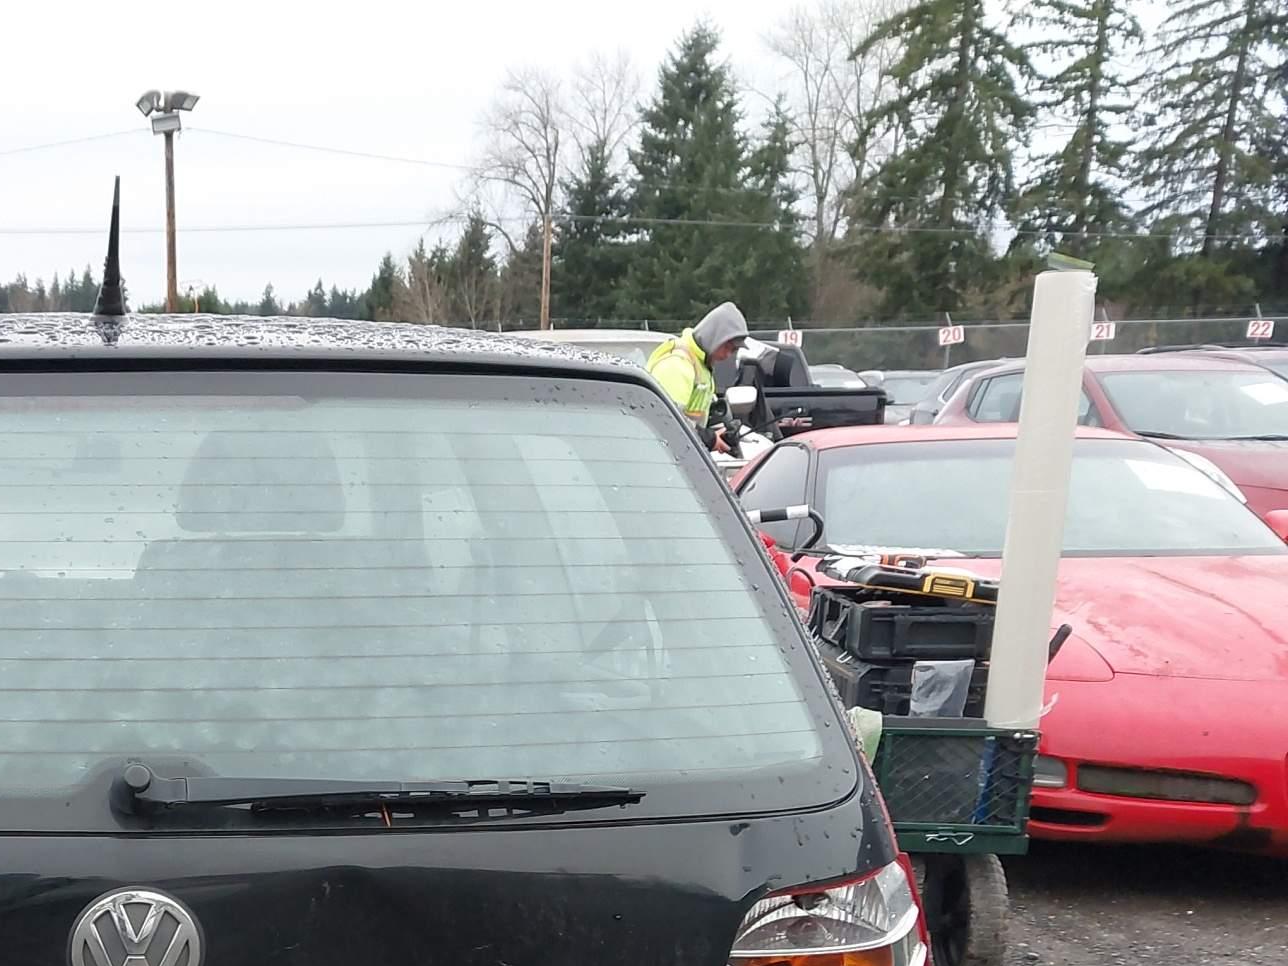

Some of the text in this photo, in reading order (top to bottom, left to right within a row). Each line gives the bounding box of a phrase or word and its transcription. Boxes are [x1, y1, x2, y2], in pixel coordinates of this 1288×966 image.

[942, 328, 962, 343] 20
[1095, 324, 1111, 338] 21
[1249, 322, 1270, 337] 22
[781, 331, 798, 345] 19
